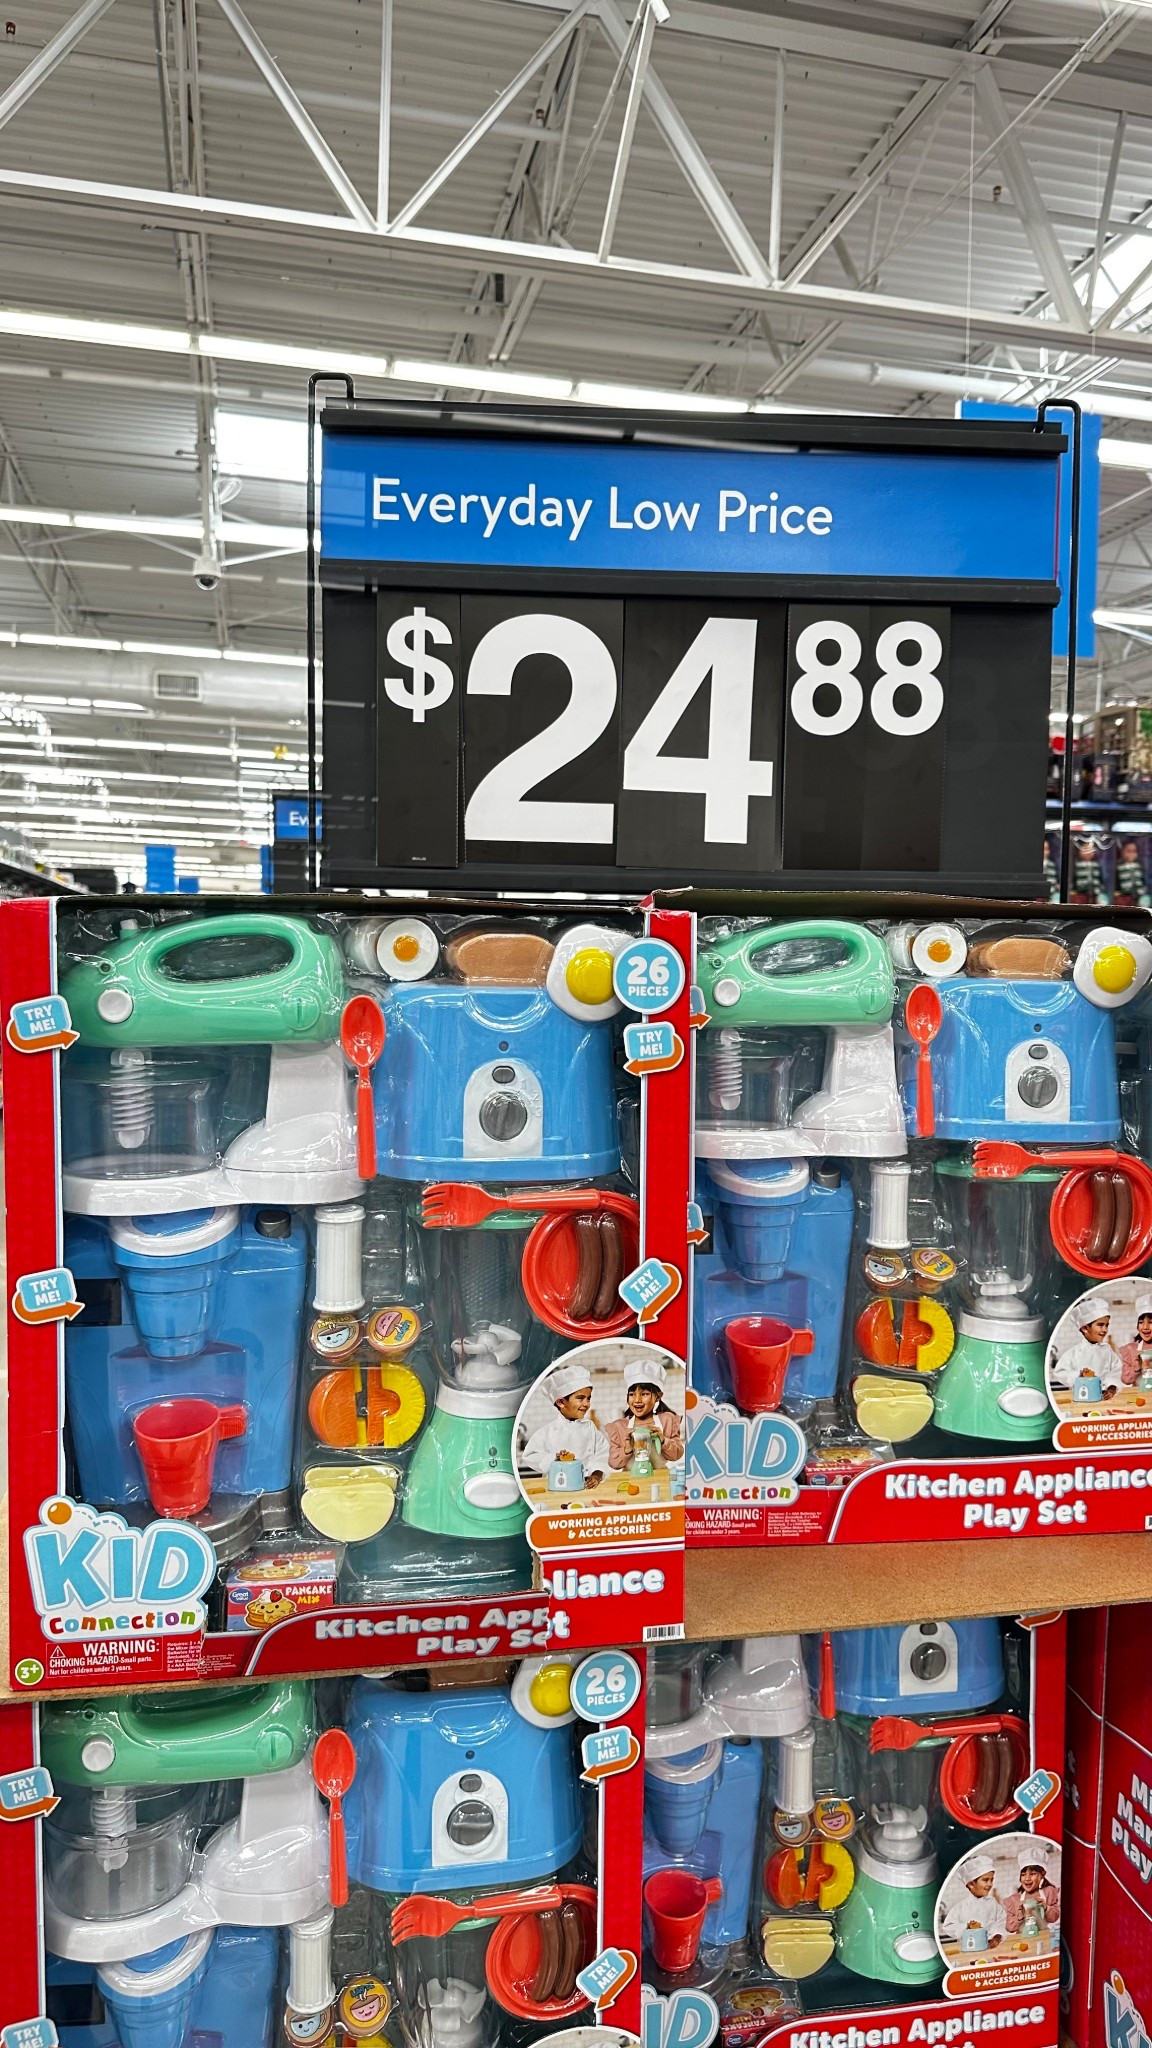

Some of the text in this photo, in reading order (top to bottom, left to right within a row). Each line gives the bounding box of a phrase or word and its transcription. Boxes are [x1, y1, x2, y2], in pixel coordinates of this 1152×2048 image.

[371, 477, 834, 541] Everyday Low Price
[627, 955, 670, 985] 26
[628, 986, 669, 996] PIECES
[24, 1003, 53, 1023] TRY
[29, 1018, 56, 1035] ME!
[637, 1030, 663, 1044] TRY
[640, 1042, 663, 1057] ME!
[29, 1275, 58, 1293] TRY
[630, 1268, 653, 1293] TRY
[35, 1289, 62, 1306] ME!
[640, 1279, 663, 1303] ME!
[1072, 1423, 1116, 1434] WORKING
[1087, 1434, 1094, 1442] &
[686, 1415, 801, 1480] KID
[685, 1486, 791, 1500] onnection
[885, 1473, 1006, 1499] Kitchen
[548, 1511, 672, 1530] WORKING APPLIANCES
[703, 1508, 763, 1521] WARNING:
[963, 1499, 1087, 1532] Play Set
[567, 1524, 652, 1539] & ACCESSORIES
[35, 1528, 206, 1608] KID
[285, 1584, 333, 1596] PANCAKE
[296, 1595, 320, 1605] MIX
[315, 1614, 470, 1640] Kitchen
[83, 1638, 160, 1657] WARNING:
[416, 1635, 500, 1656] Play
[50, 1656, 86, 1669] CHOKING
[137, 1656, 154, 1664] parts.
[50, 1668, 61, 1676] Not
[60, 1667, 69, 1675] for
[69, 1666, 94, 1675] children
[116, 1664, 133, 1673] years.
[20, 1663, 40, 1680] 3+
[586, 1664, 627, 1695] 26
[587, 1693, 626, 1707] PIECES
[595, 1734, 620, 1750] TRY
[597, 1747, 620, 1762] ME!
[8, 1775, 35, 1792] TRY
[1023, 1777, 1042, 1796] TRY
[13, 1787, 39, 1804] ME!
[1031, 1785, 1047, 1804] ME!
[588, 1958, 611, 1981] TRY
[597, 1966, 619, 1990] ME!
[960, 1961, 1051, 1981] WORKING APPLIANCES
[975, 1972, 1037, 1988] & ACCESSORIES
[14, 2024, 41, 2041] TRY
[907, 2005, 1046, 2044] Appliance
